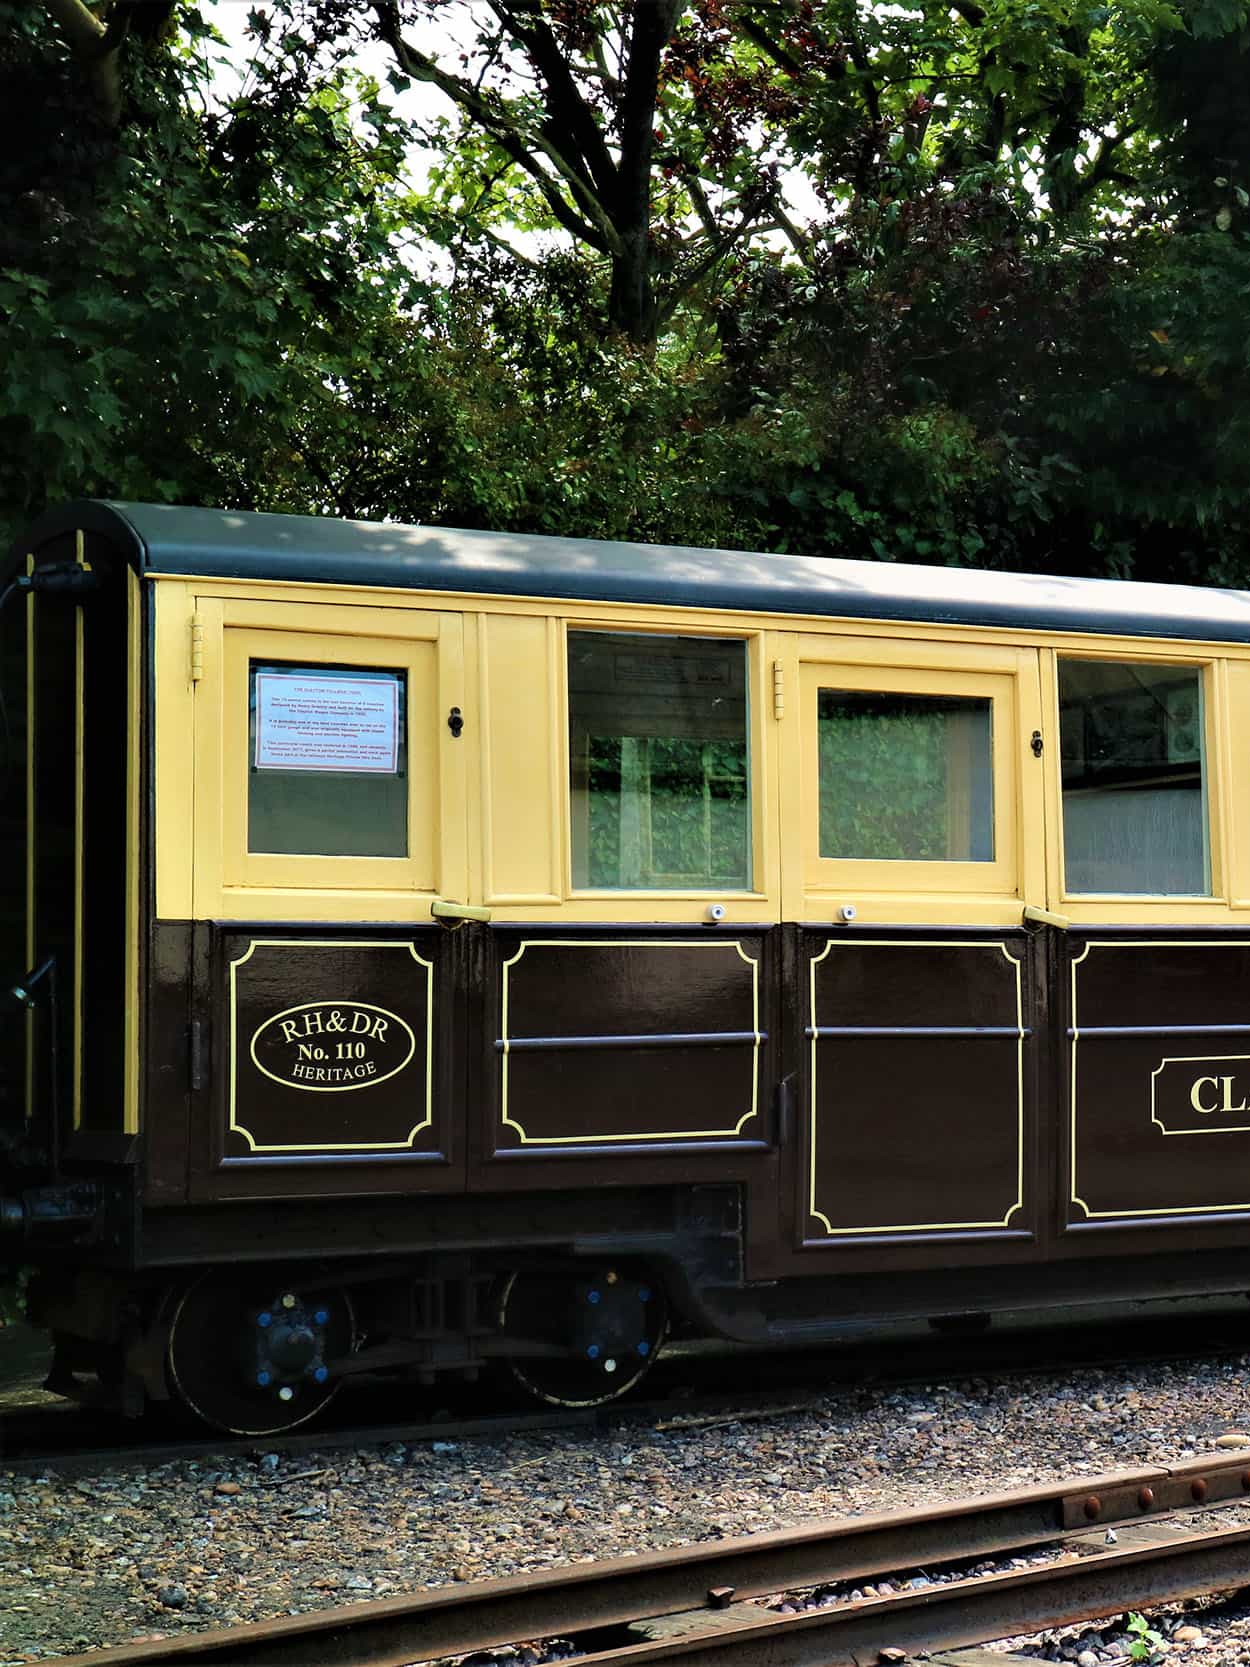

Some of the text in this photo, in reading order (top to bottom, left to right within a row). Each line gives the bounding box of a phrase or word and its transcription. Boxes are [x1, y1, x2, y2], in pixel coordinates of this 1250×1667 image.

[279, 1010, 389, 1043] RH&DR
[298, 1042, 366, 1061] No. 110
[291, 1061, 377, 1081] HERITAGE
